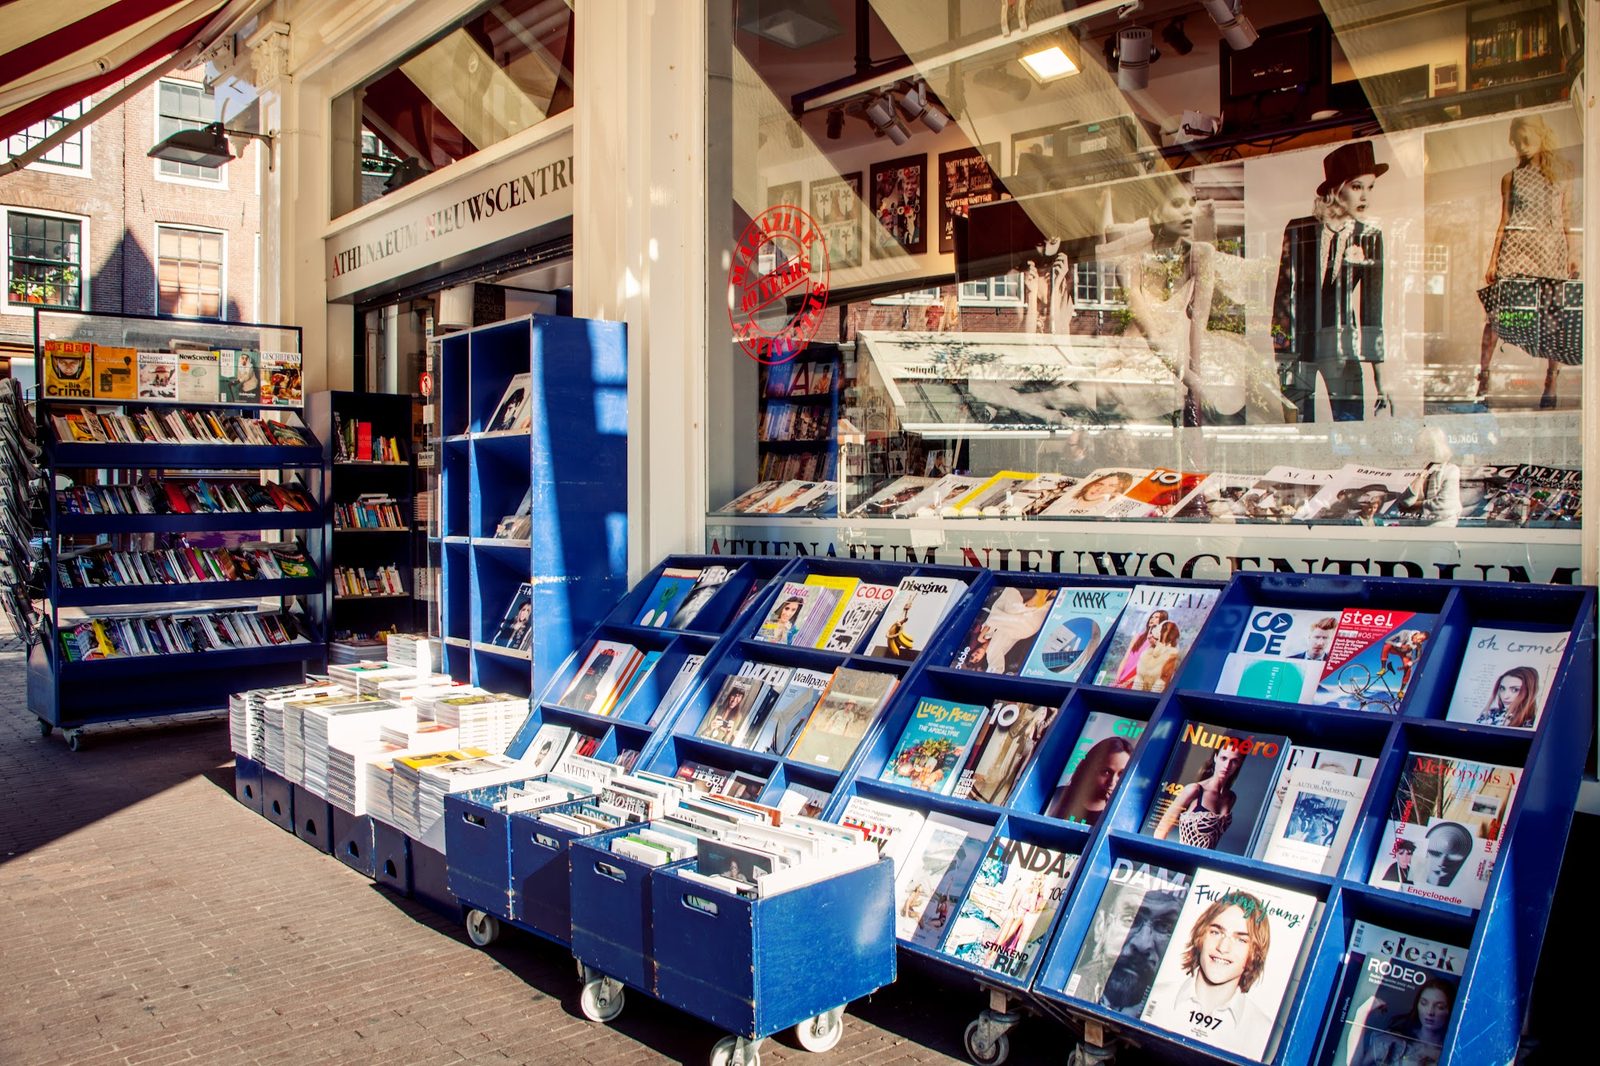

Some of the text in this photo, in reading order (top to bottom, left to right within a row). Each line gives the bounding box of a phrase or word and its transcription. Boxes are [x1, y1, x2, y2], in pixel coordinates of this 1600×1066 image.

[732, 212, 817, 286] MAGAZINE
[759, 255, 812, 299] YEARS
[47, 385, 91, 397] Crime
[1150, 469, 1181, 485] 10
[1357, 468, 1392, 477] DAPPER
[900, 579, 949, 596] Disegno.
[1072, 591, 1110, 609] MARK
[1134, 591, 1208, 611] METAL
[1341, 610, 1393, 627] steel
[1478, 634, 1499, 651] oh
[737, 661, 791, 689] DAZED
[989, 702, 1019, 727] 10
[1181, 723, 1279, 759] Numéro
[1413, 756, 1501, 785] Metropolis
[1161, 781, 1184, 796] 142
[1407, 885, 1462, 905] Encyclopedie
[1256, 898, 1305, 928] Young!
[982, 941, 1029, 963] STINKEND
[1381, 936, 1455, 973] sleek
[1367, 957, 1427, 985] RODEO
[1188, 1009, 1223, 1031] 1997
